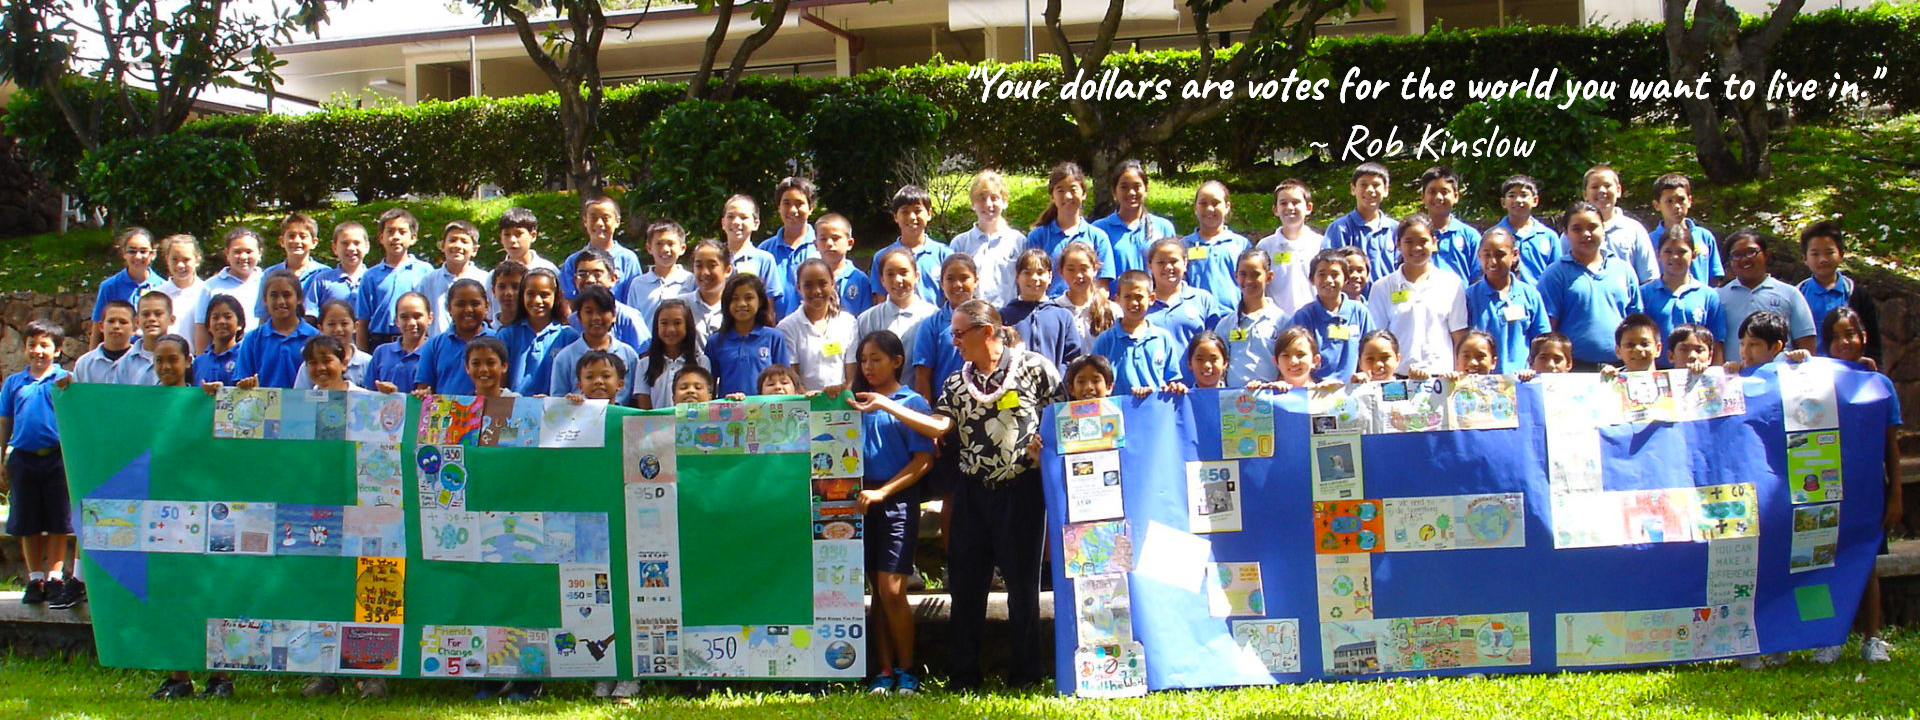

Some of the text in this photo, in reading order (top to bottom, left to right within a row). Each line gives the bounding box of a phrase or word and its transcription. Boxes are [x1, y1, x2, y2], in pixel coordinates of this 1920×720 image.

[567, 578, 586, 589] 390
[815, 623, 863, 640] 350
[702, 635, 738, 662] 350
